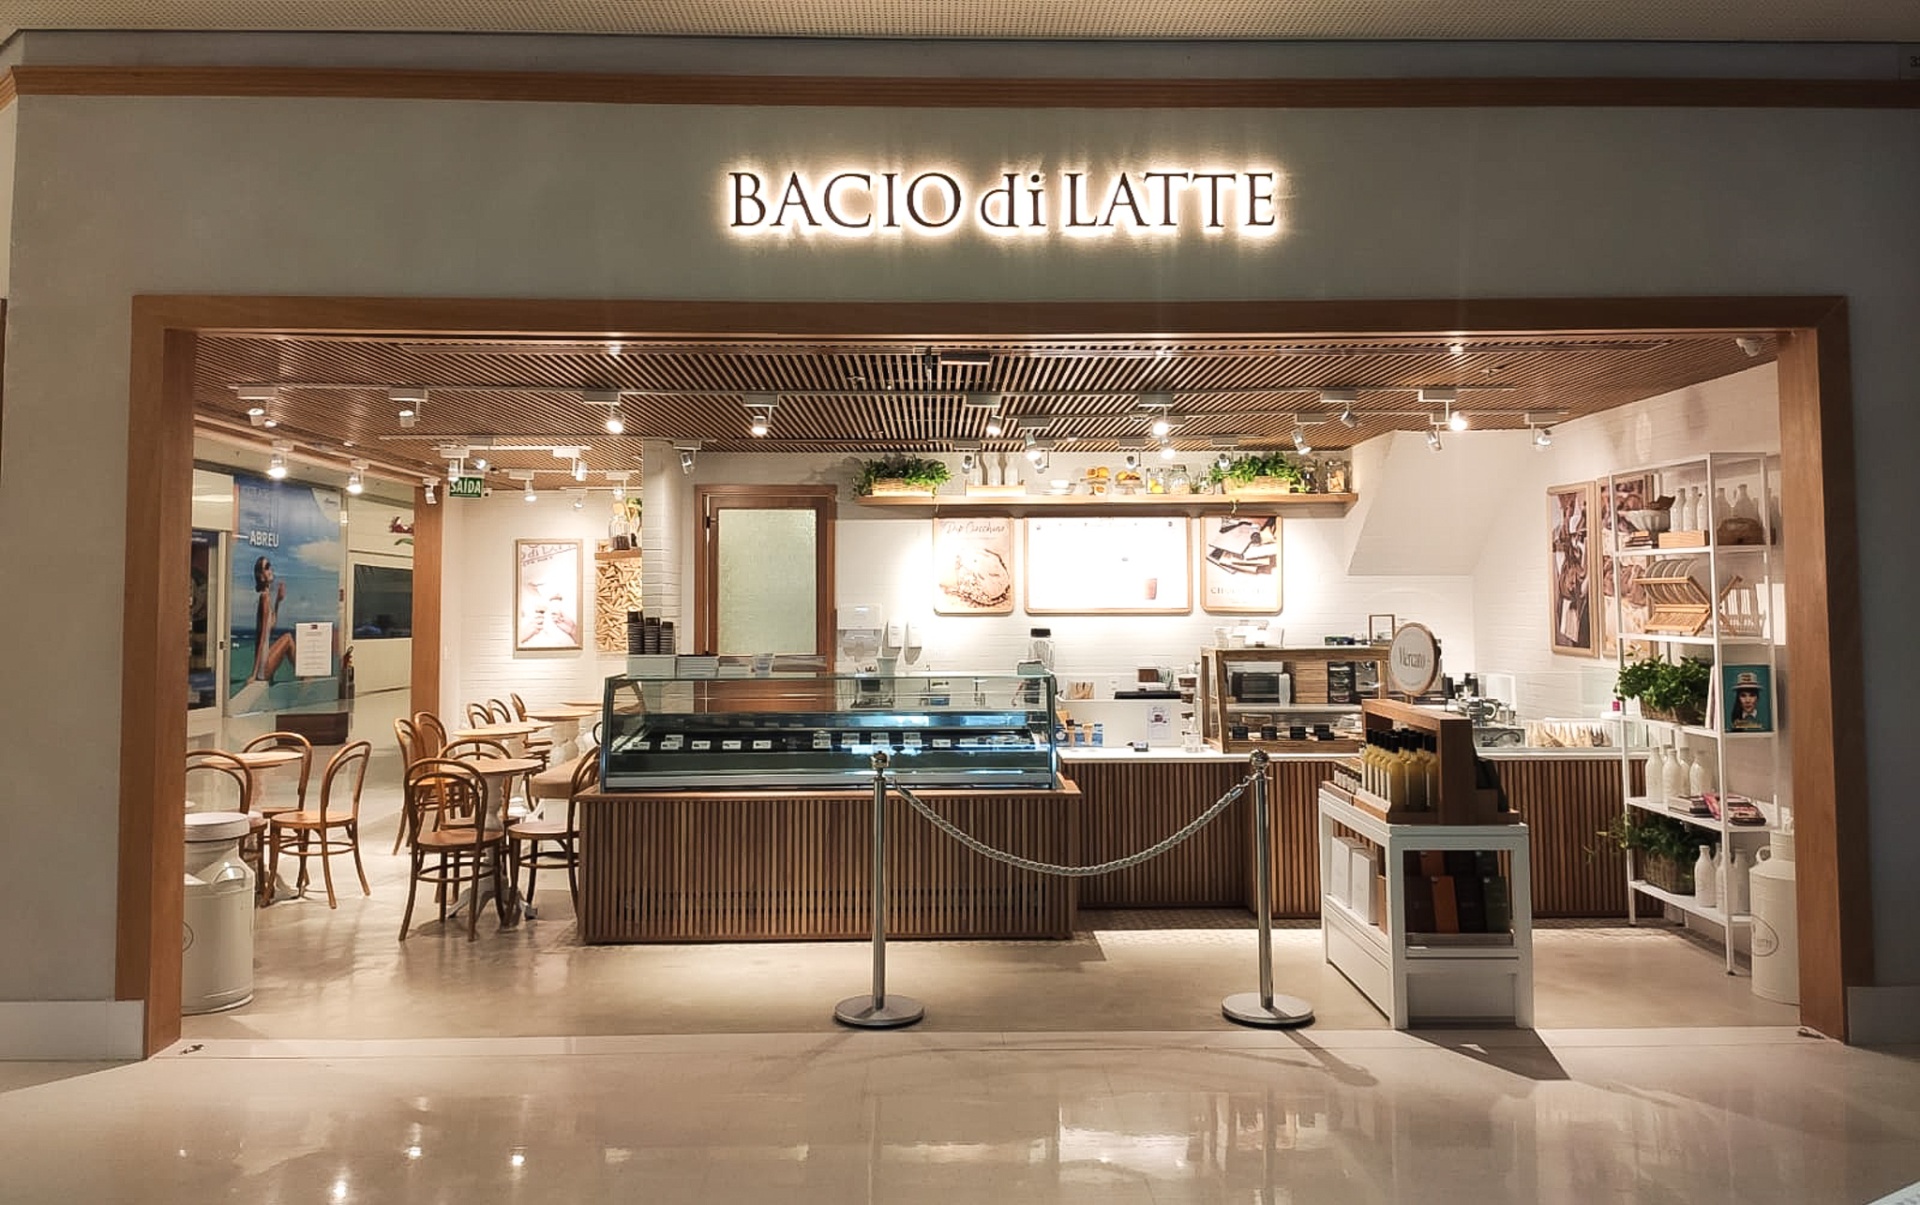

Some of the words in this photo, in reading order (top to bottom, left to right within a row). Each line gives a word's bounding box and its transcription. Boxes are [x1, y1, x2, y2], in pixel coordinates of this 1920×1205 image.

[728, 171, 961, 229] BACIO
[980, 172, 1047, 229] di
[1064, 171, 1276, 229] LATTE
[450, 478, 481, 494] SAÍDA
[249, 530, 279, 548] ABREU
